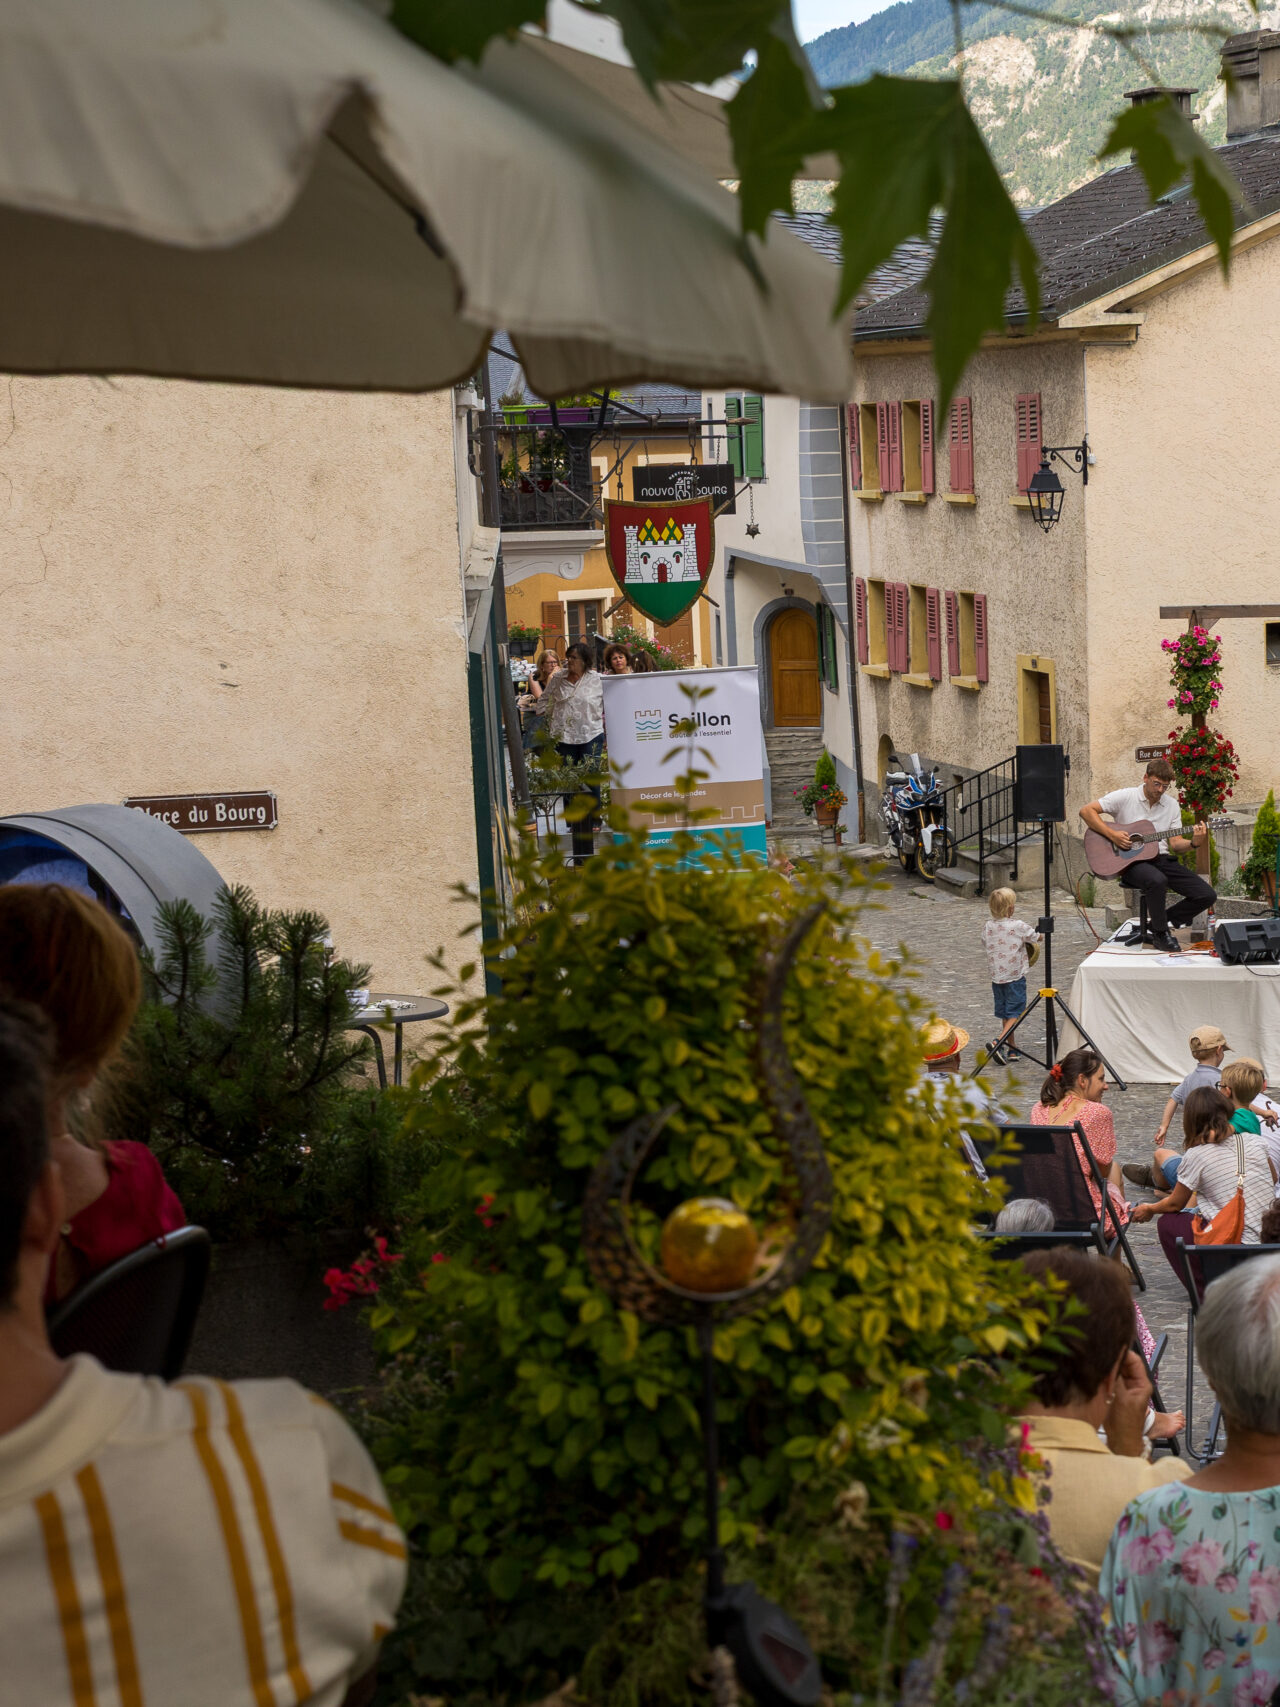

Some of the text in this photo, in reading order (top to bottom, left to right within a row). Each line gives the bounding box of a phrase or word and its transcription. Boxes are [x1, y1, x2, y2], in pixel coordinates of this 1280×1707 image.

[668, 712, 731, 728] Sillon
[640, 792, 661, 800] Décor
[188, 805, 208, 823] du
[215, 803, 266, 823] Bourg
